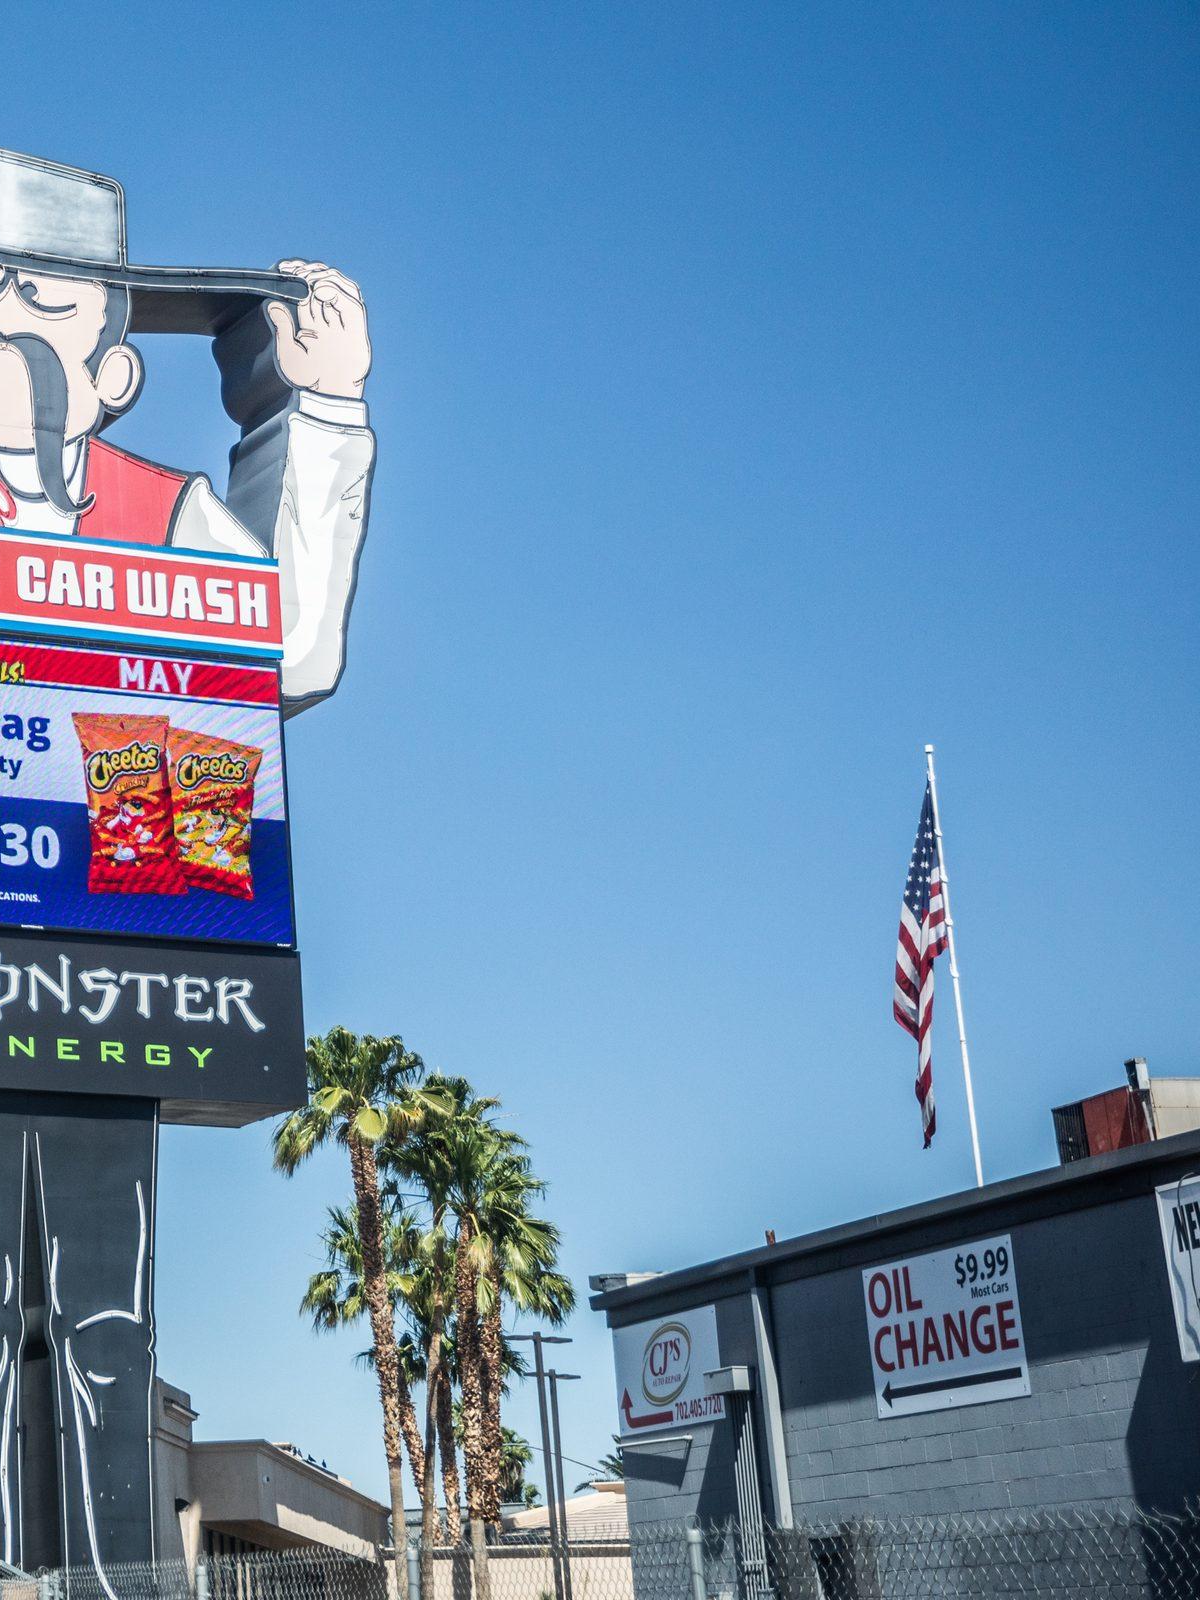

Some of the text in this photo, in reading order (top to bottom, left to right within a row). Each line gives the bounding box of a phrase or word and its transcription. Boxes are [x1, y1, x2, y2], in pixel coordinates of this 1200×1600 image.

[16, 555, 115, 611] CAR
[125, 568, 268, 628] WASH
[119, 657, 193, 694] MAY
[87, 741, 161, 792] Cheetos
[177, 753, 248, 789] Cheetos
[954, 1246, 1009, 1288] $9.99
[971, 1281, 1009, 1299] Most Cars
[868, 1266, 923, 1319] OIL
[874, 1300, 1020, 1373] CHANGE
